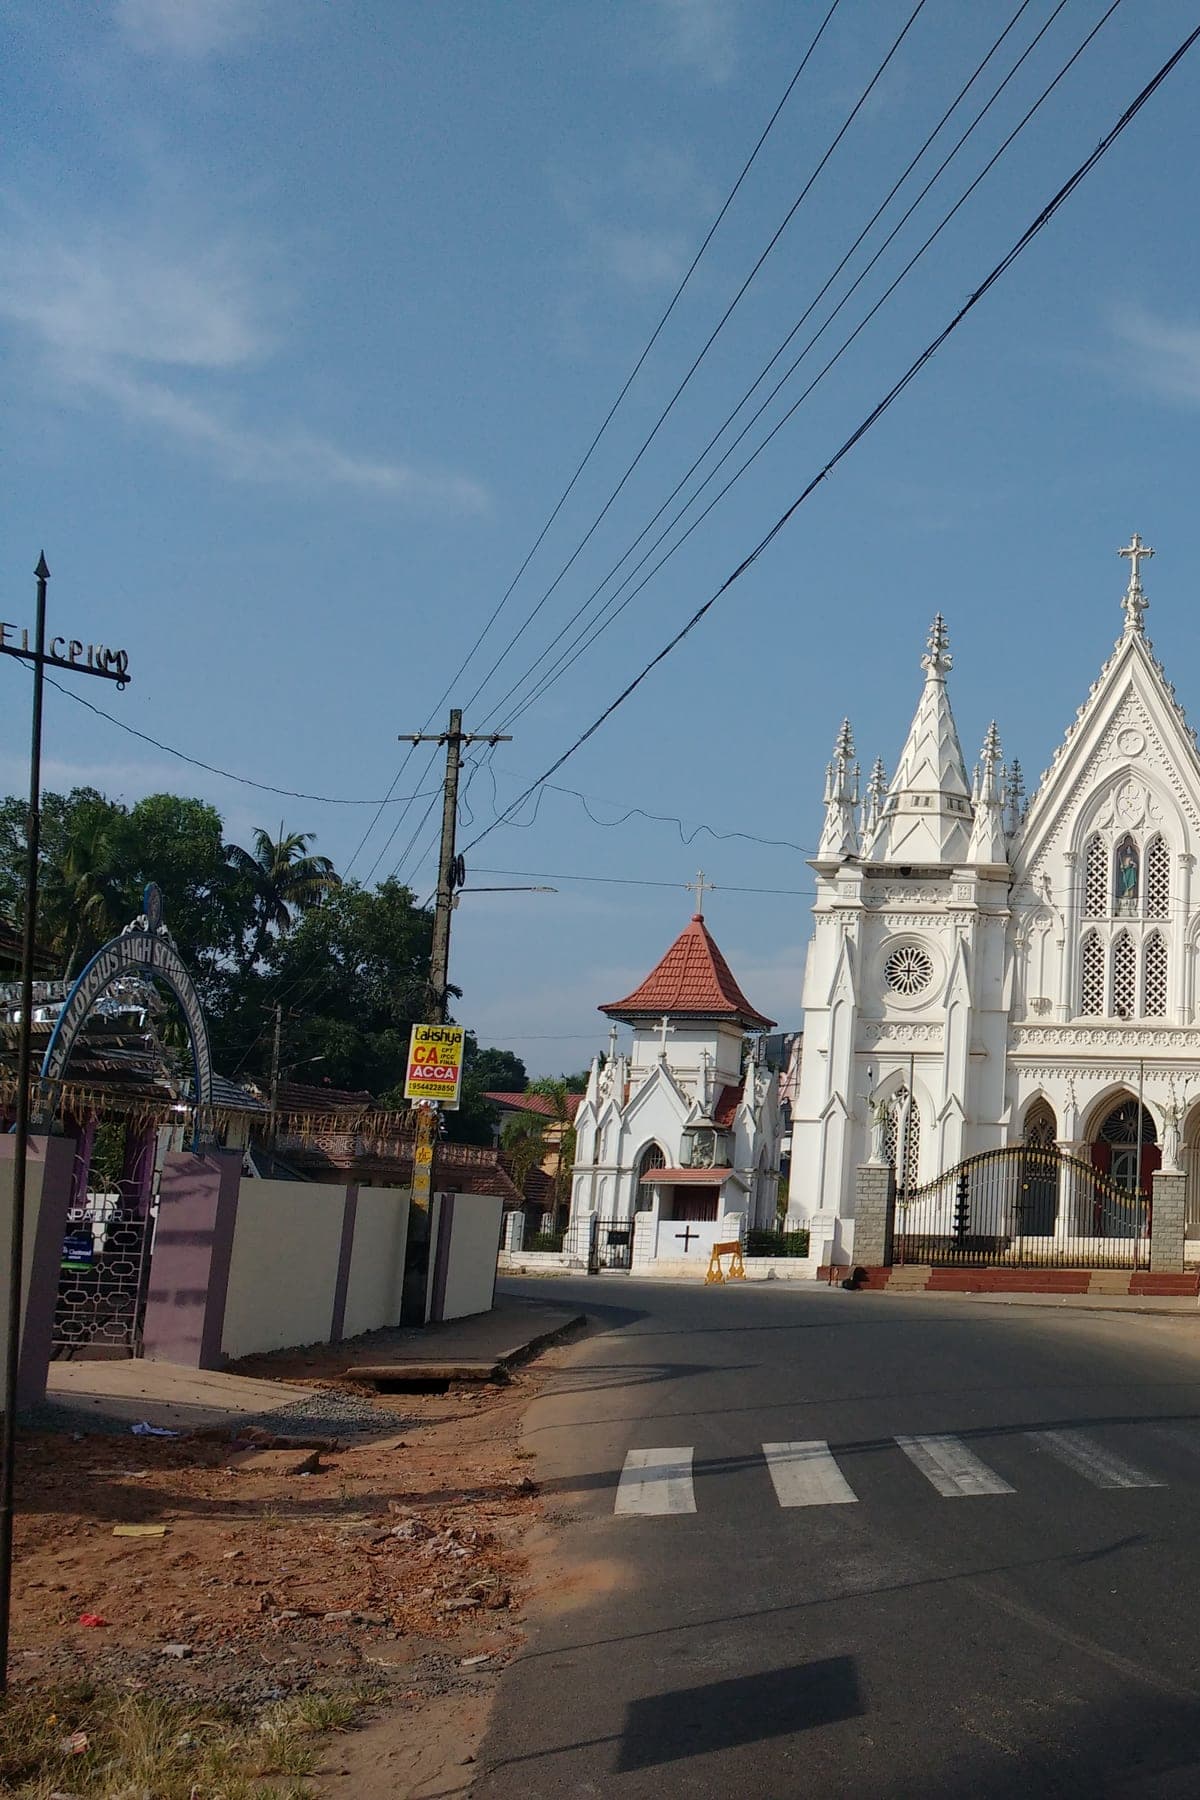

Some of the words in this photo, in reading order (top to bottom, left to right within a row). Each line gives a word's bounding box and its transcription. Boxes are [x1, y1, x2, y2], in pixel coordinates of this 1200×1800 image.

[120, 936, 150, 967] HIGH
[153, 942, 190, 1000] SCHOOL
[415, 1027, 462, 1046] Lakshya
[413, 1046, 438, 1064] CA
[412, 1066, 454, 1079] ACCA
